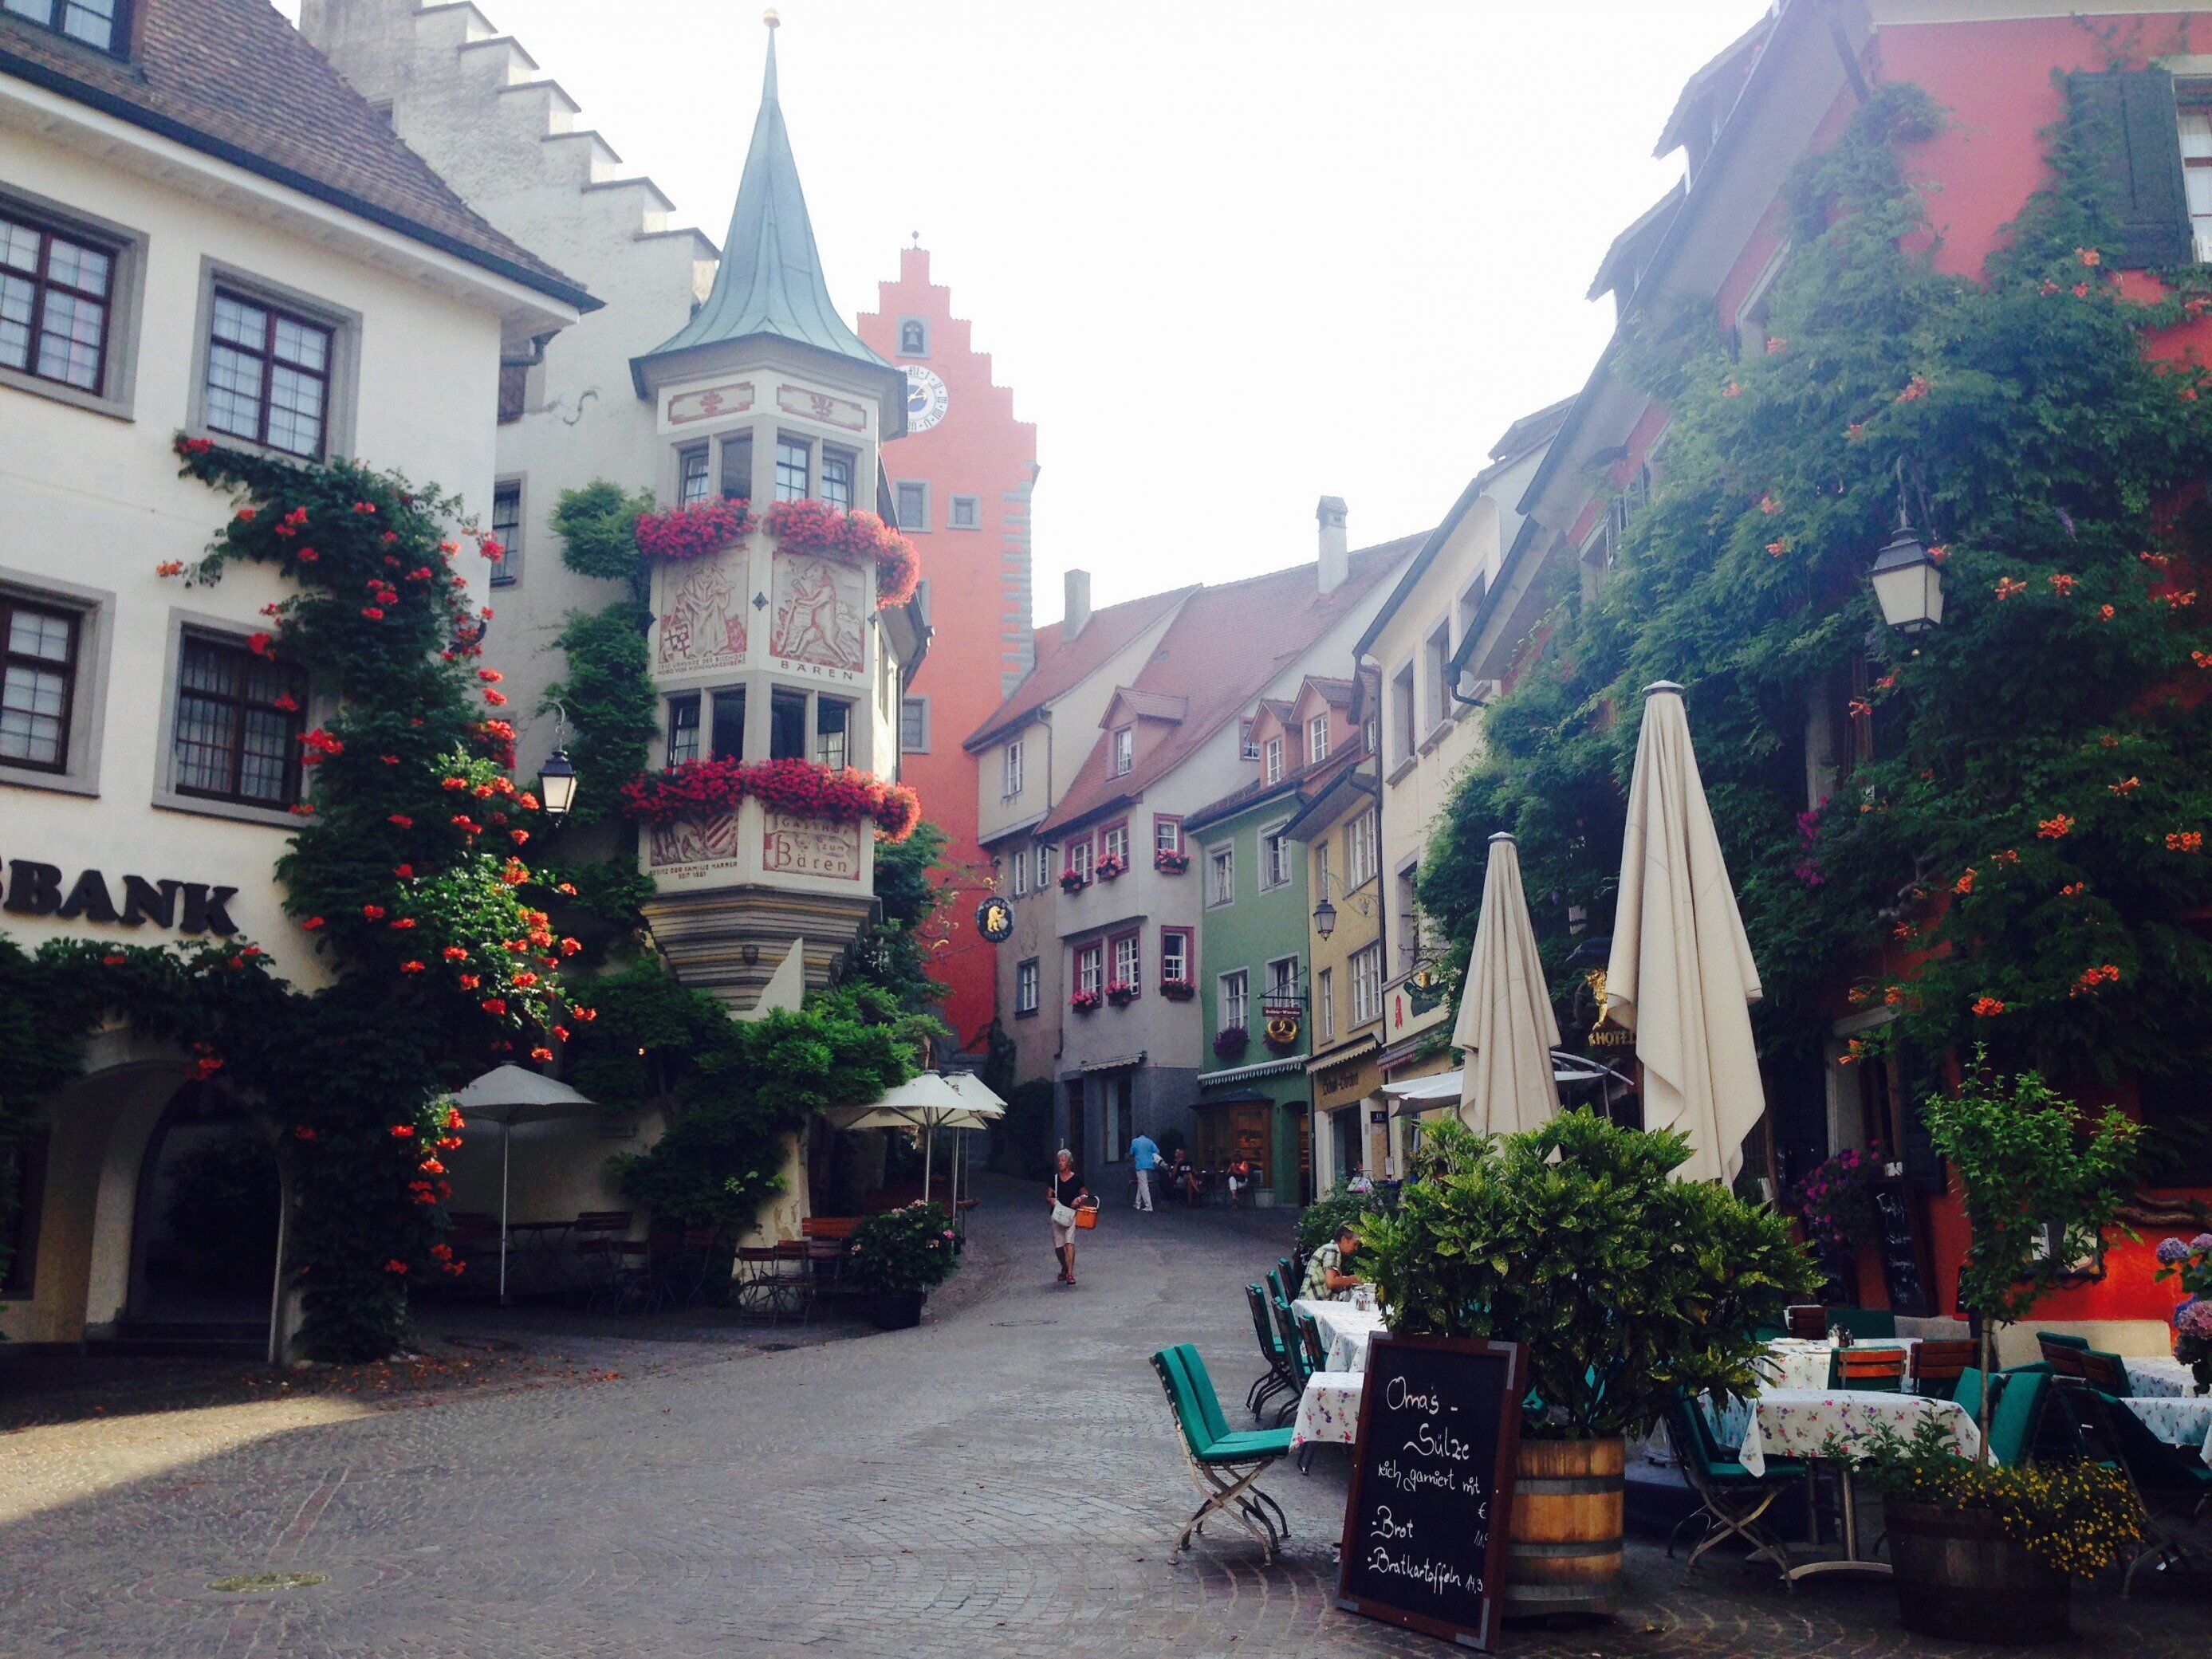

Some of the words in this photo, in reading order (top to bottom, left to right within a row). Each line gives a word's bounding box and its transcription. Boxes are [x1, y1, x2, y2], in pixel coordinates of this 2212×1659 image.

[781, 660, 853, 681] BÄREN
[774, 834, 848, 873] Bären
[0, 854, 239, 937] BANK
[1403, 1422, 1470, 1460] Sülze
[1403, 1468, 1456, 1492] garniert
[1462, 1476, 1481, 1496] mit
[1370, 1505, 1414, 1539] Brot
[1368, 1547, 1462, 1595] Bratkartoffeln
